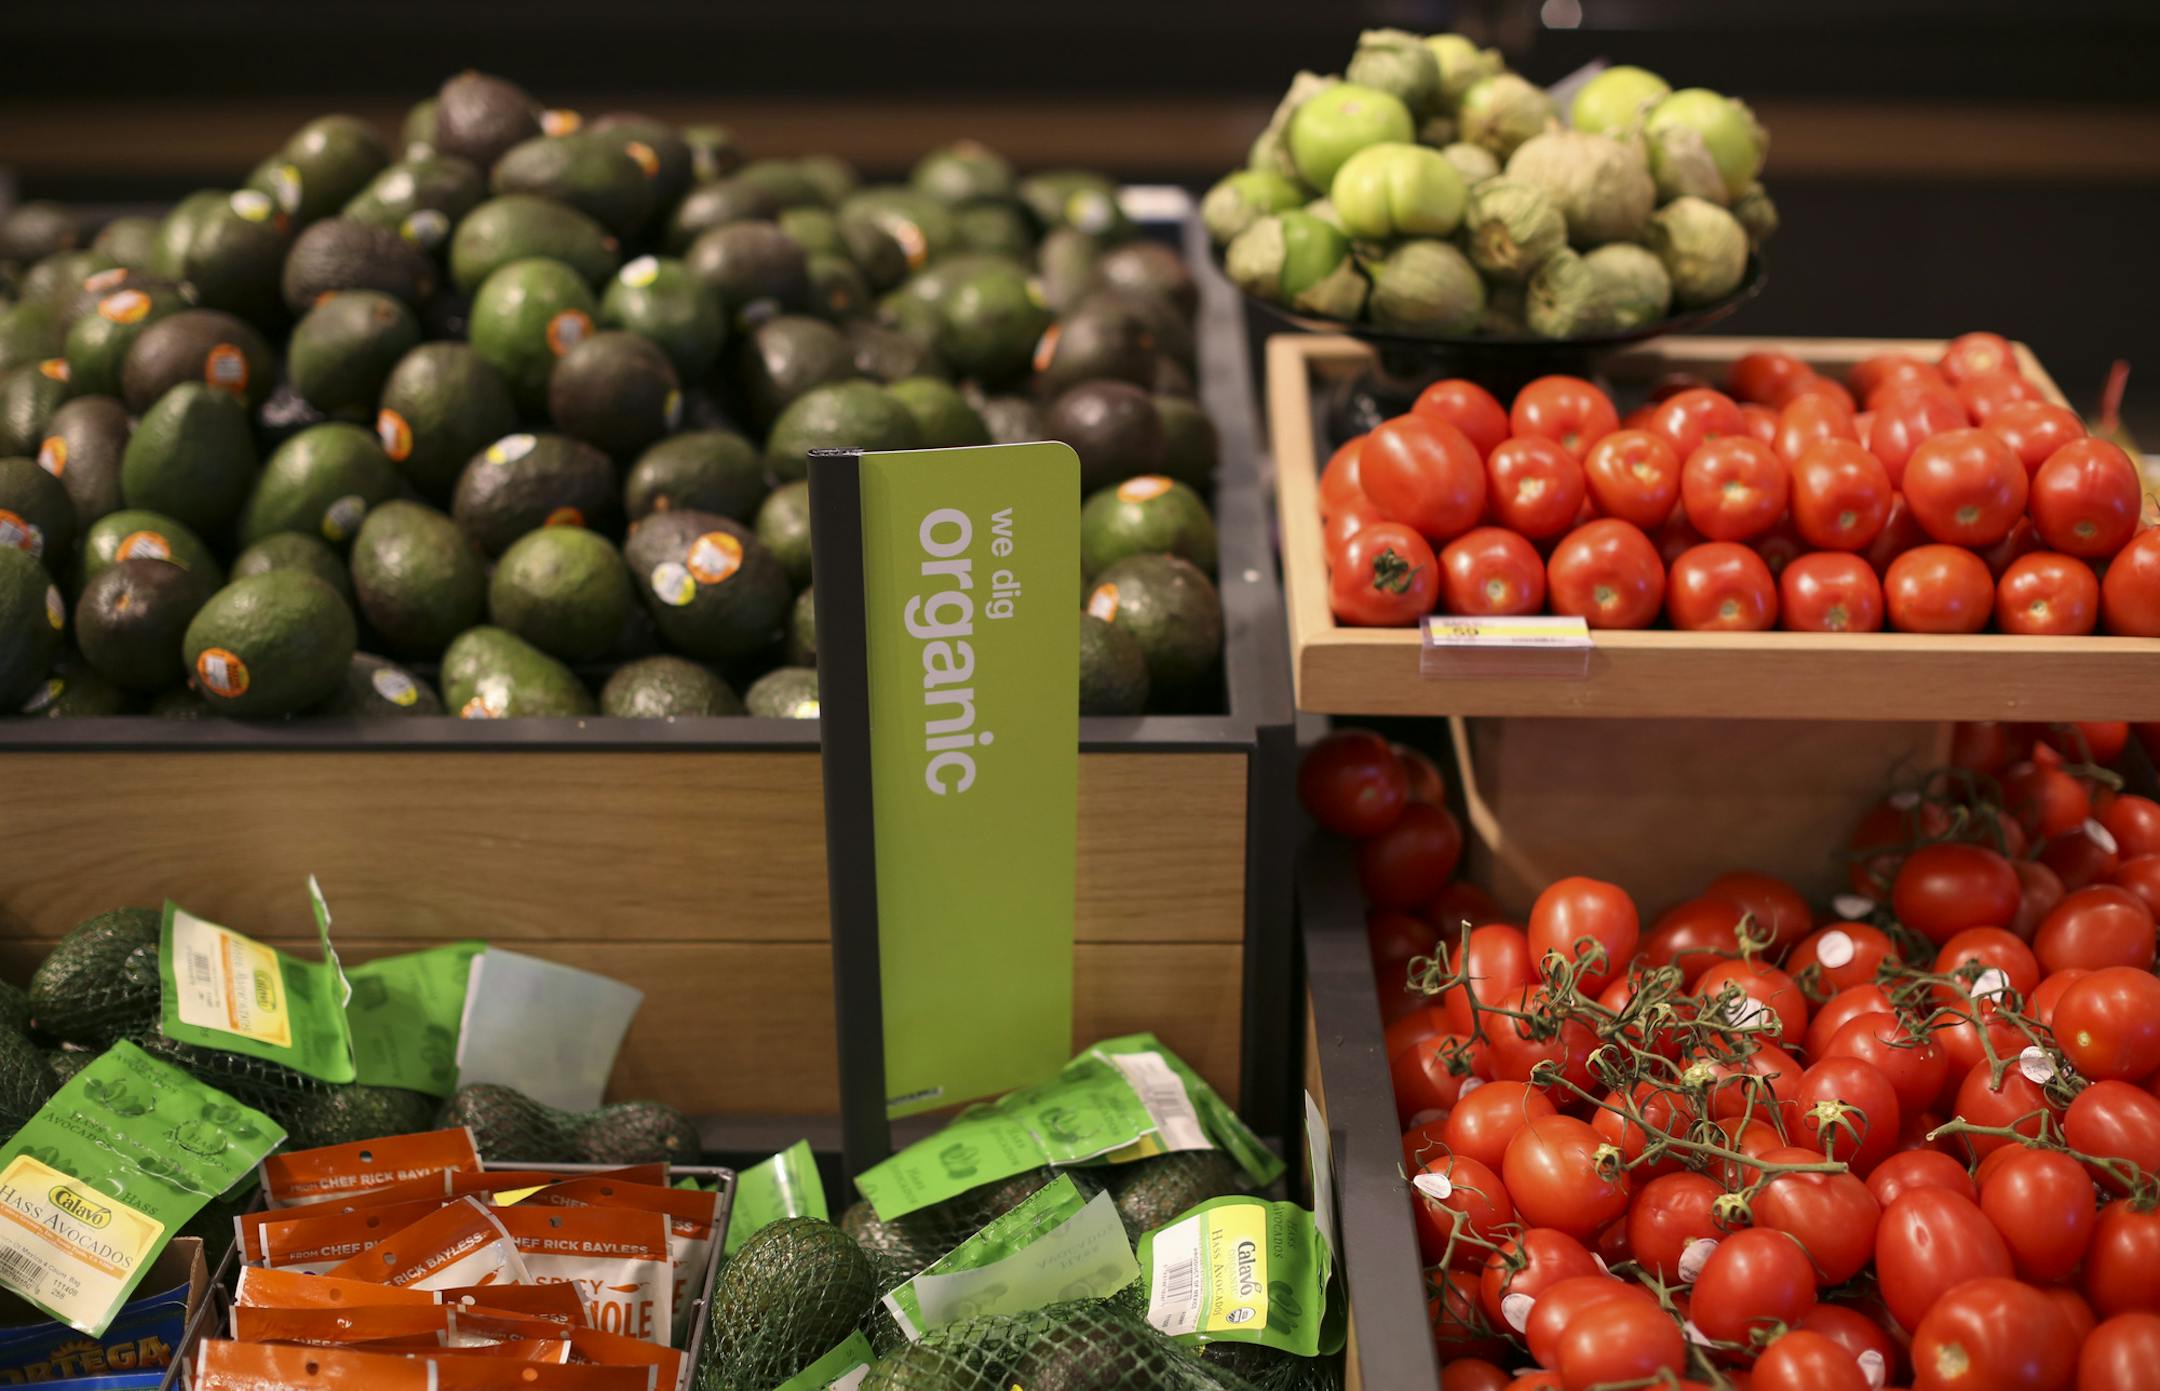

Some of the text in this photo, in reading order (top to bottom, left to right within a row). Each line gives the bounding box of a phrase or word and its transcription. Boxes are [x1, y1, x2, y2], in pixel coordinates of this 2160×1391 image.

[985, 507, 1021, 620] we dig
[904, 508, 994, 796] organic
[319, 1175, 357, 1190] CHEF
[360, 1171, 394, 1186] RICK
[0, 1184, 44, 1219] HASS
[44, 1212, 134, 1269] AVOCADOS
[54, 1189, 108, 1227] Calavo
[1272, 1205, 1283, 1259] AVOCADOS
[290, 1250, 318, 1260] FROM
[320, 1242, 360, 1257] CHEF
[393, 1232, 485, 1286] RICK BAYLESS
[512, 1236, 649, 1255] HEF RICK BAYLESS
[1211, 1228, 1225, 1317] HASS AVOCADOS
[1238, 1241, 1260, 1297] Calavo
